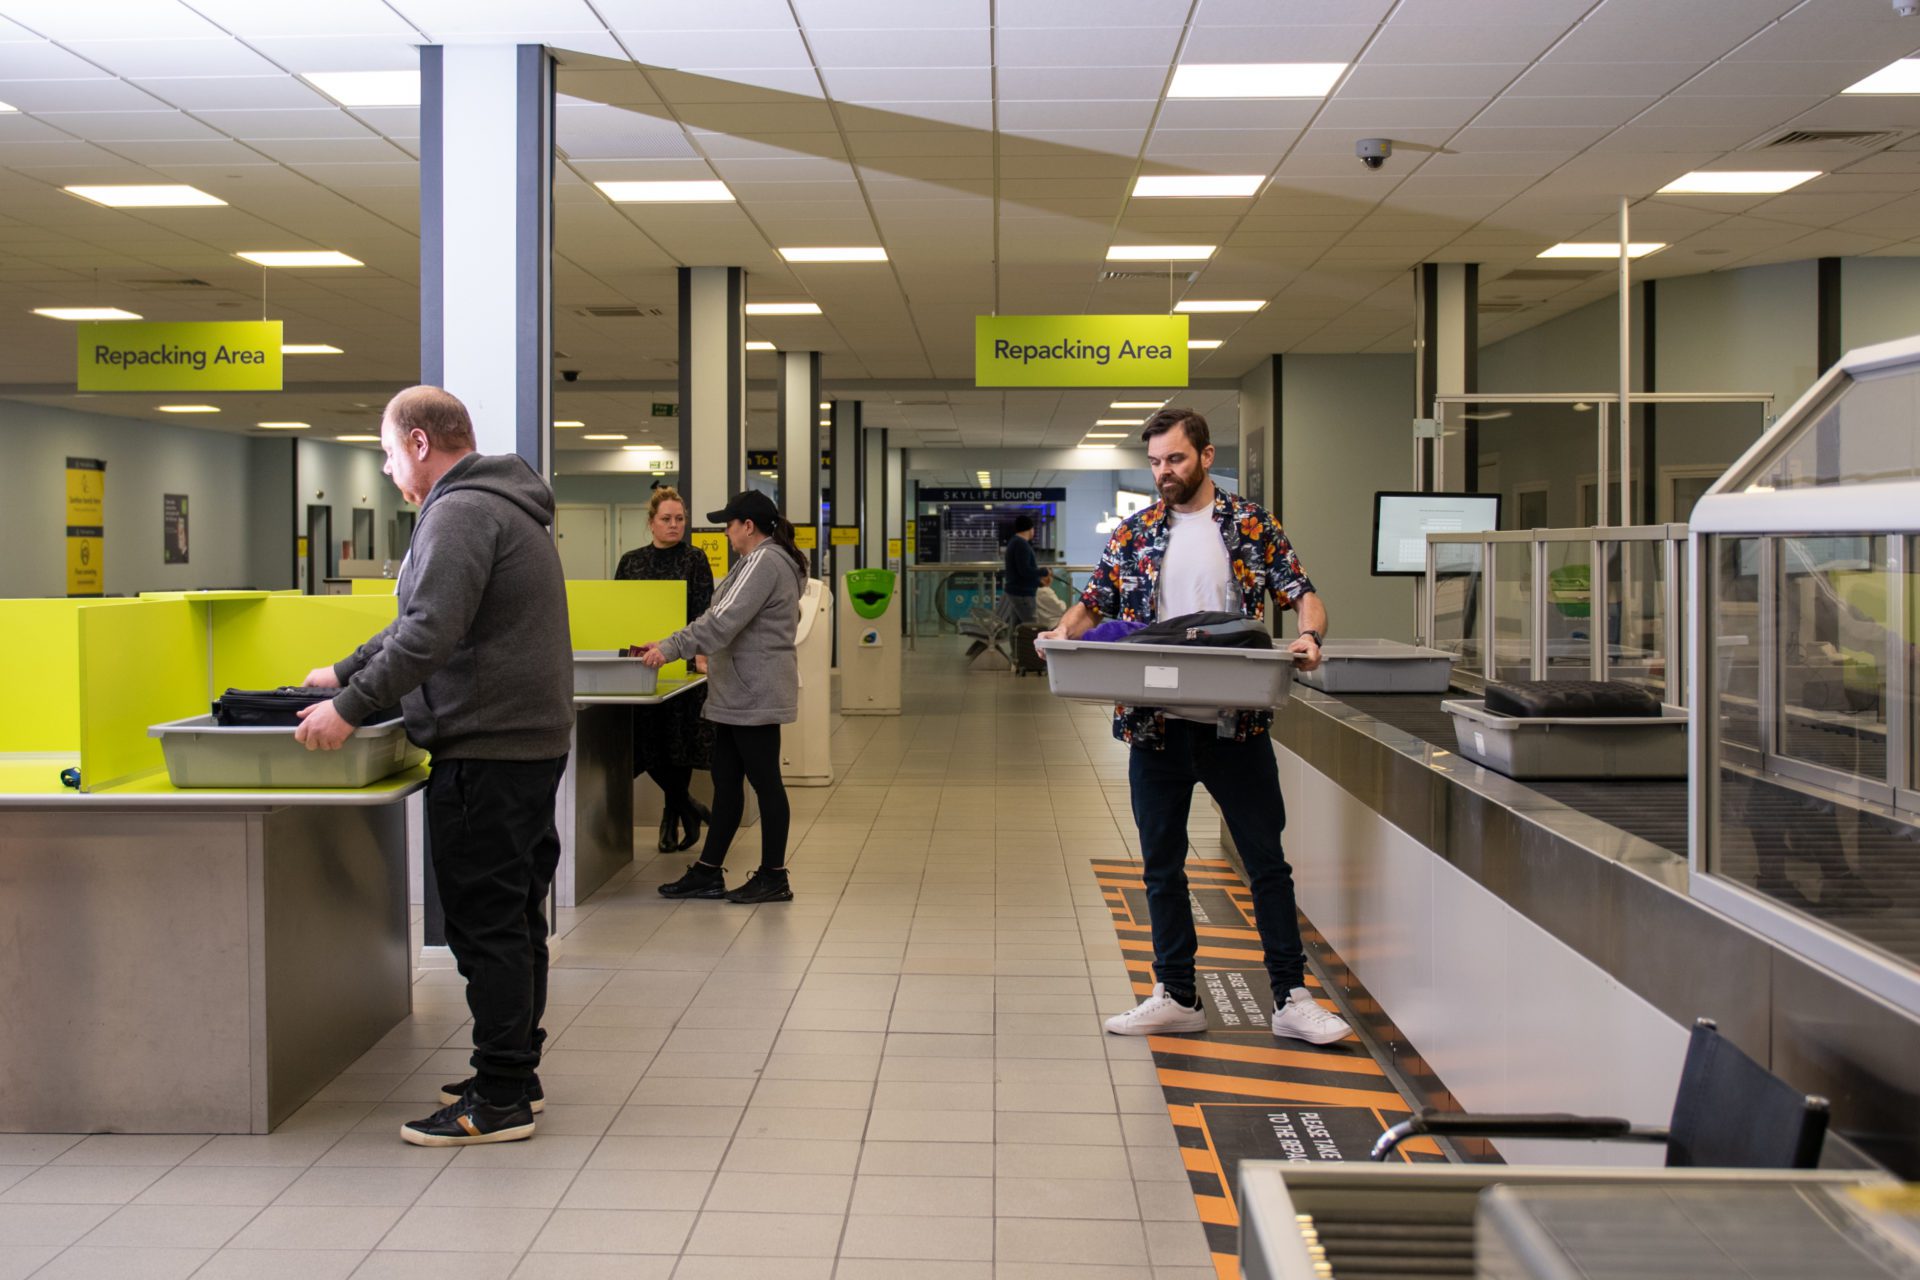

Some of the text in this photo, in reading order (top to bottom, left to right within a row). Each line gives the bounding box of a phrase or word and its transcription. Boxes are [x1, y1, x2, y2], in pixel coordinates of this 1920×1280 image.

[95, 343, 265, 370] Repacking Area
[995, 338, 1172, 365] Repacking Area
[755, 455, 769, 465] To
[943, 489, 1043, 502] SKYLIFE lounge
[943, 529, 997, 538] SKYLIFE
[1206, 980, 1224, 988] THE
[1209, 988, 1236, 1013] REPACKING
[1226, 972, 1269, 1026] PLEASE TAKE YOUR TRAY
[1220, 1013, 1241, 1026] AREA
[1267, 1112, 1290, 1124] TO
[1273, 1124, 1298, 1138] THE
[1299, 1112, 1342, 1159] PLEASE TAKE
